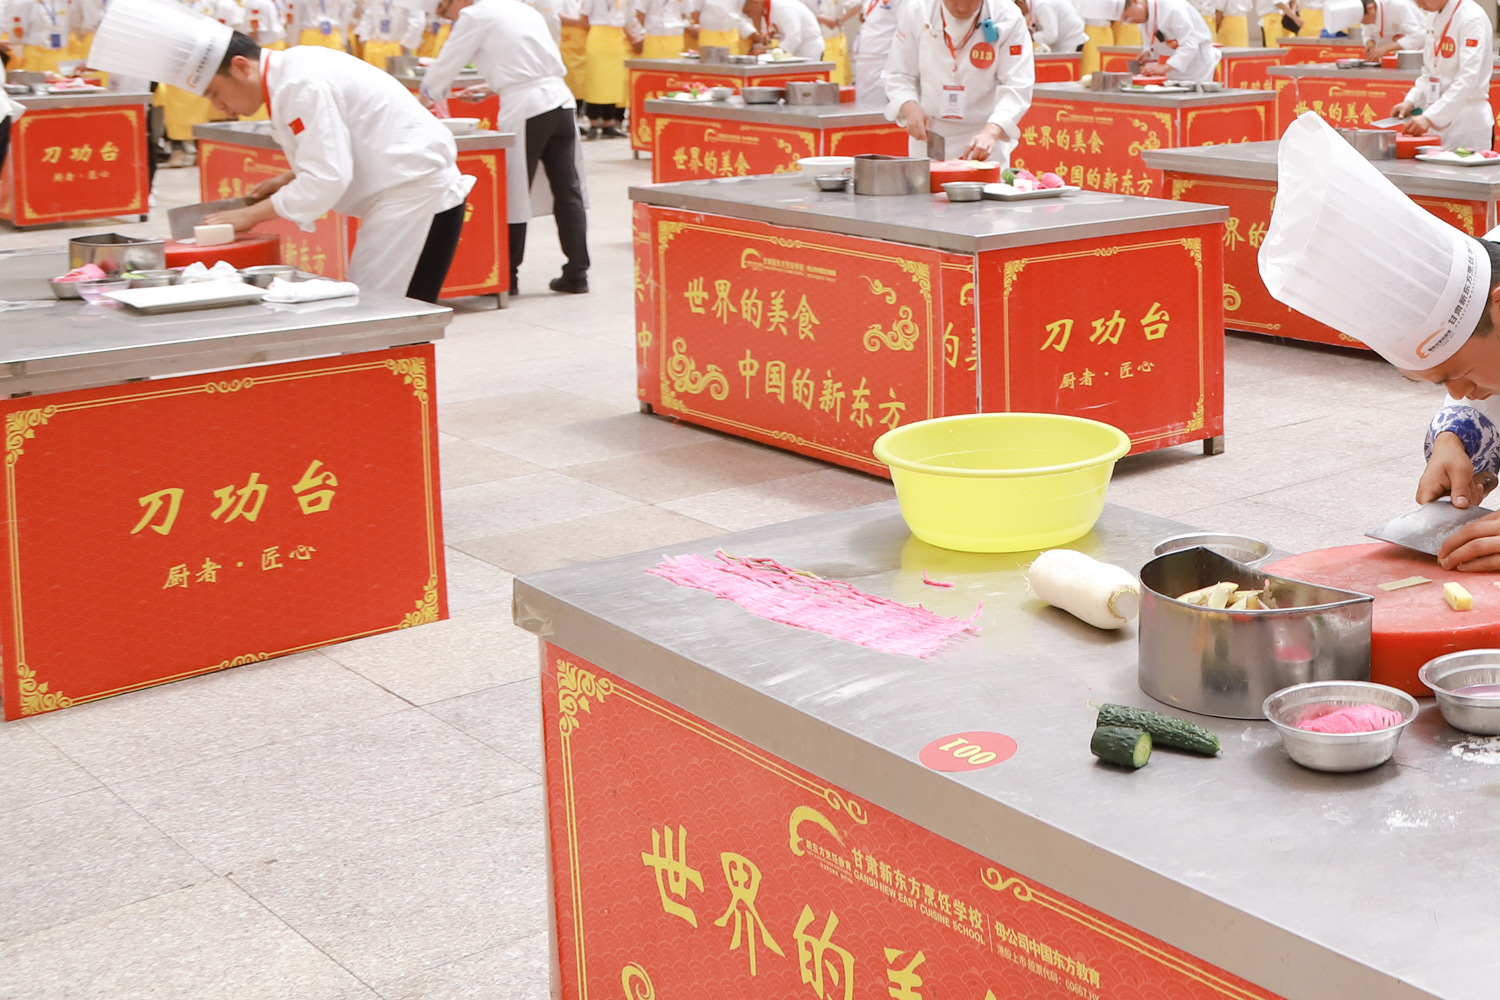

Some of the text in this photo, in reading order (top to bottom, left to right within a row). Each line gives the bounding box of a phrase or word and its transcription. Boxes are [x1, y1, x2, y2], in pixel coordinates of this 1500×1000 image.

[971, 49, 993, 61] 013
[40, 140, 120, 165] 刀功台
[1022, 124, 1105, 155] 世界的美食
[1054, 160, 1154, 197] 中国的新东方
[683, 275, 822, 343] 世界的美食
[1039, 301, 1171, 353] 刀功台
[737, 348, 908, 430] 中国的新东方
[129, 458, 340, 536] 刀功台
[850, 846, 985, 934] 甘肃新东方烹饪学校
[853, 867, 987, 946] GANSU NEW EAST CUISINE SCHOOL
[994, 920, 1102, 989] 母公司中国东方教育
